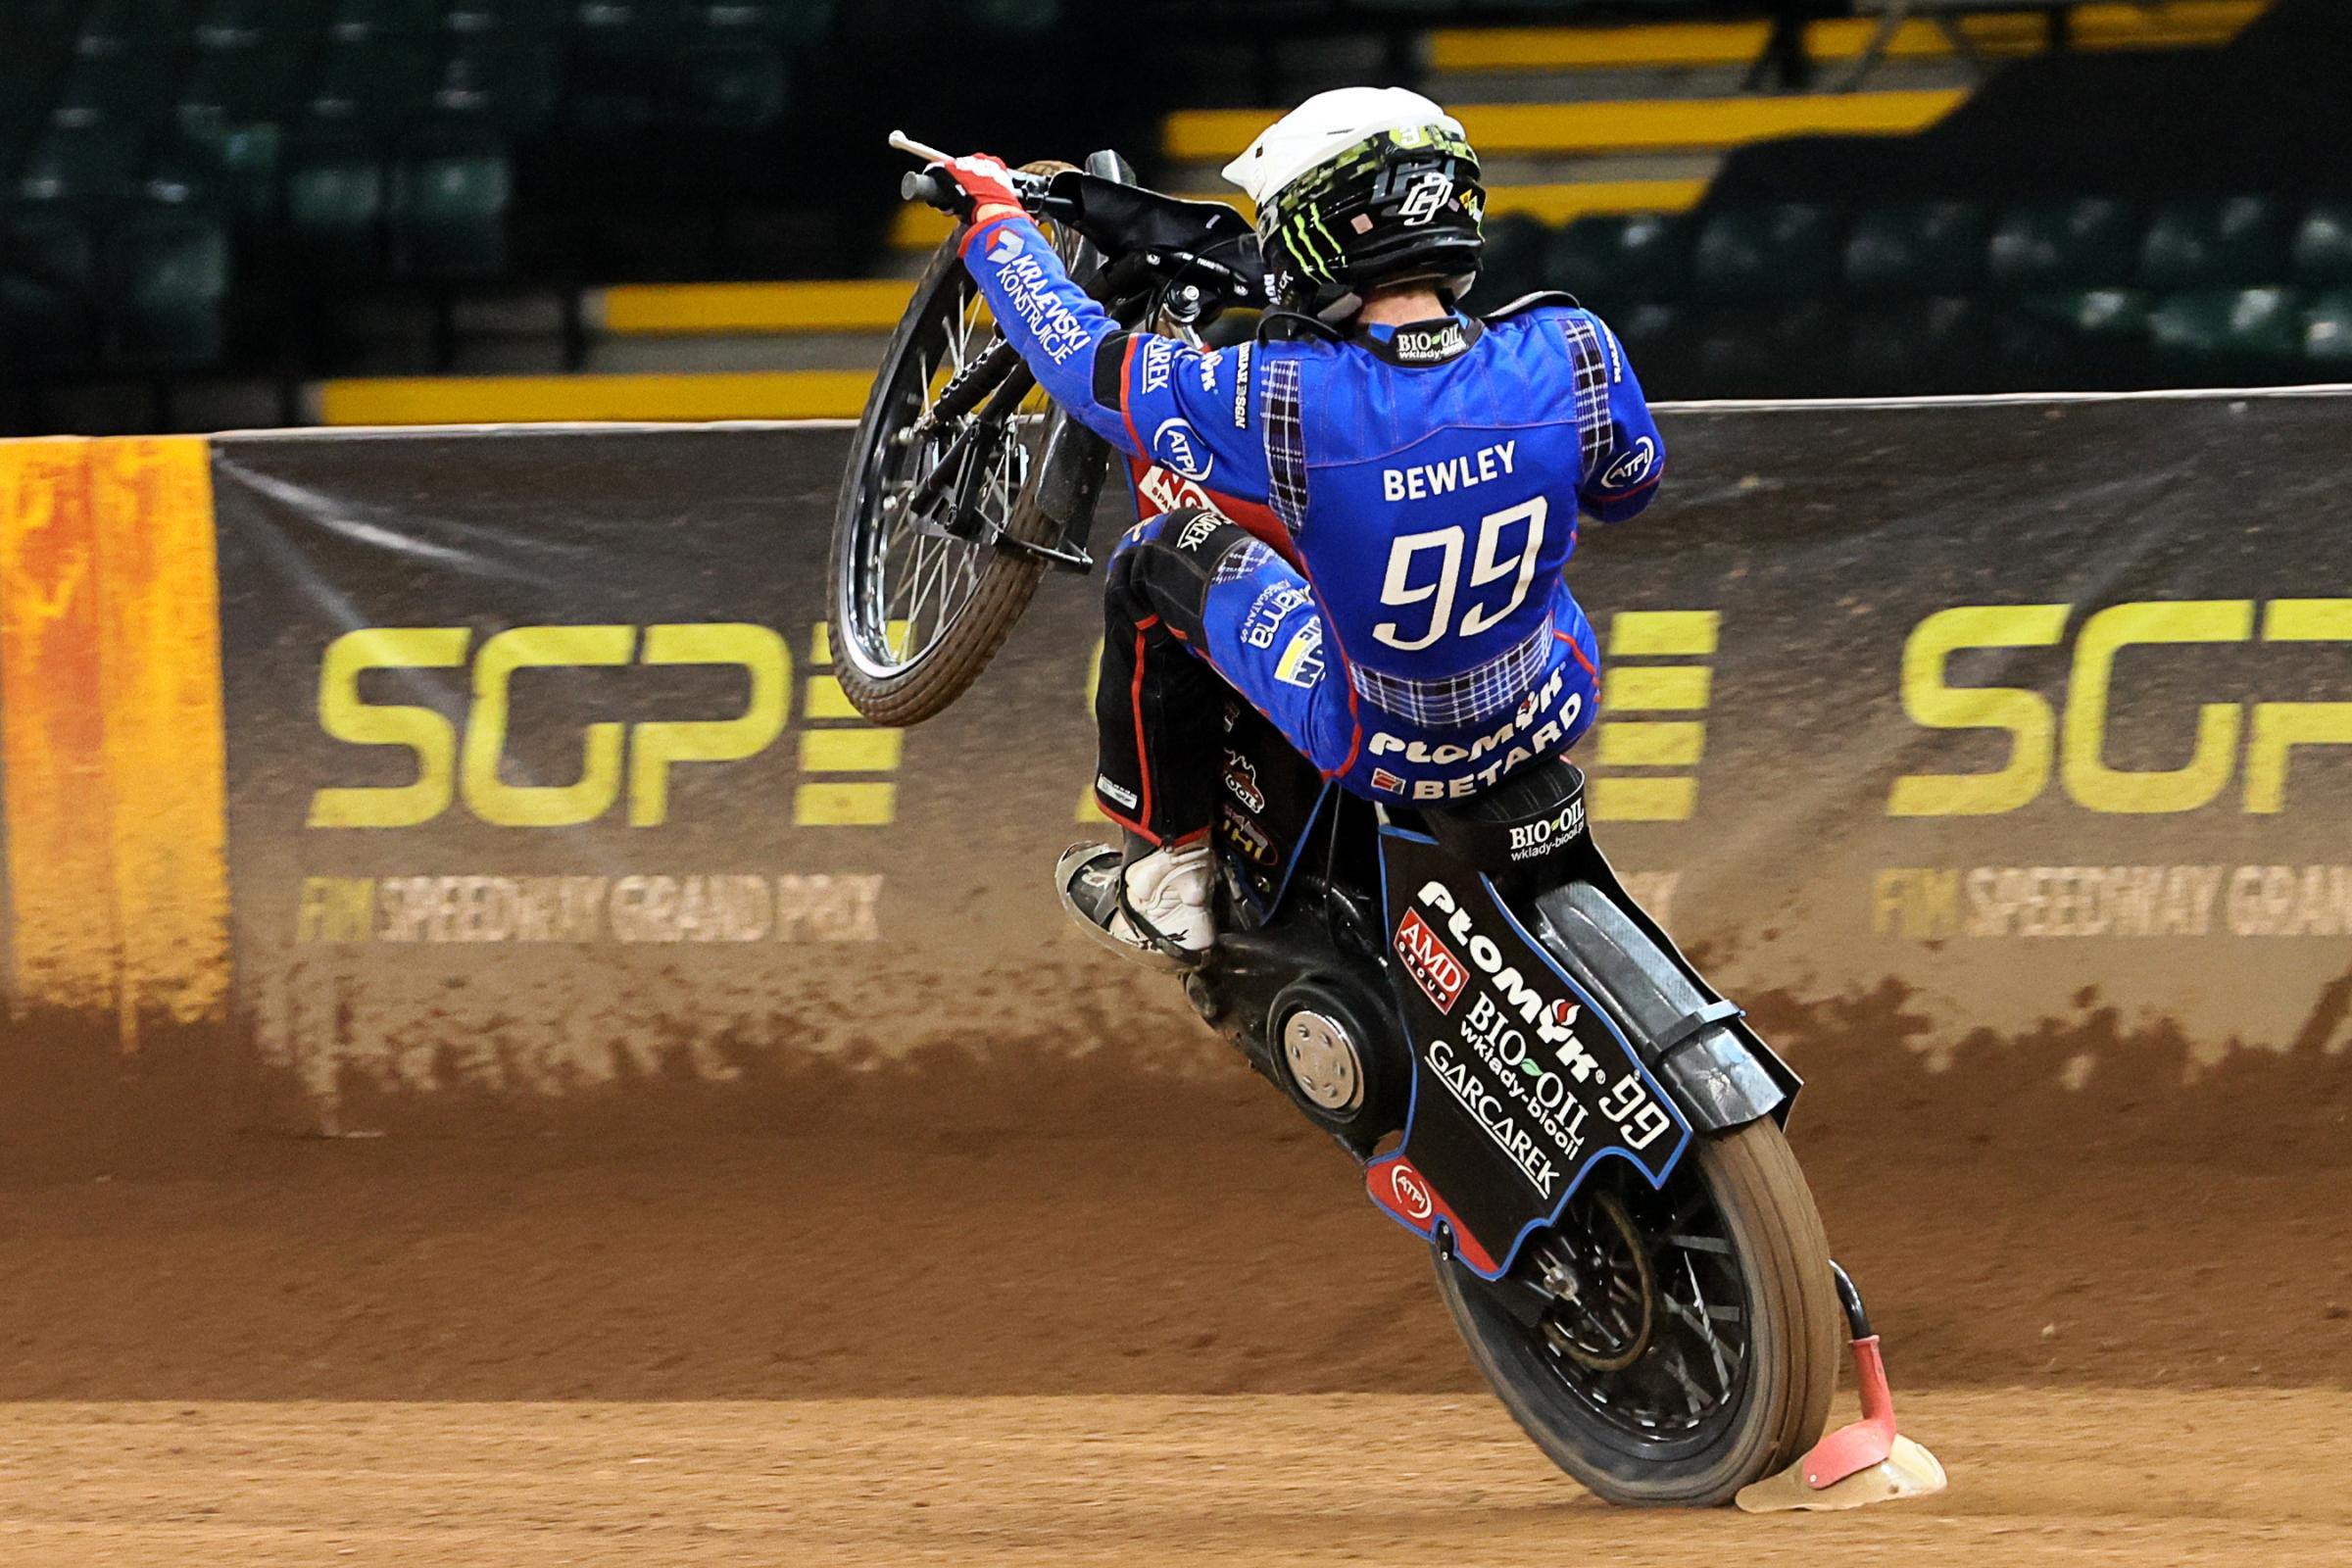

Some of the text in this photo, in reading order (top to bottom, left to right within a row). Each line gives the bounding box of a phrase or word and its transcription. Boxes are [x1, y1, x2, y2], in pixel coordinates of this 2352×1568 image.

[1012, 254, 1092, 352] KRAJEWSKI
[1396, 332, 1431, 352] BIO
[1166, 430, 1198, 473] ATPI
[1383, 439, 1516, 501] BEWLEY
[1610, 448, 1648, 477] ATPI
[1372, 496, 1548, 651] 99
[305, 621, 793, 828] SGP
[1412, 692, 1583, 801] BETARD
[1509, 797, 1585, 851] BIO OIL
[375, 874, 612, 944] SPEEDWAY
[610, 874, 774, 944] GRAND
[776, 874, 884, 944] PRIX
[1964, 865, 2226, 937] SPEEDWAY
[1397, 942, 1446, 1003] GROUP
[1400, 922, 1461, 993] AMD
[1466, 990, 1589, 1147] BIO OIL
[1429, 1040, 1560, 1196] GARCAREK
[1597, 1073, 1671, 1151] 99
[1396, 1176, 1426, 1209] ATPI
